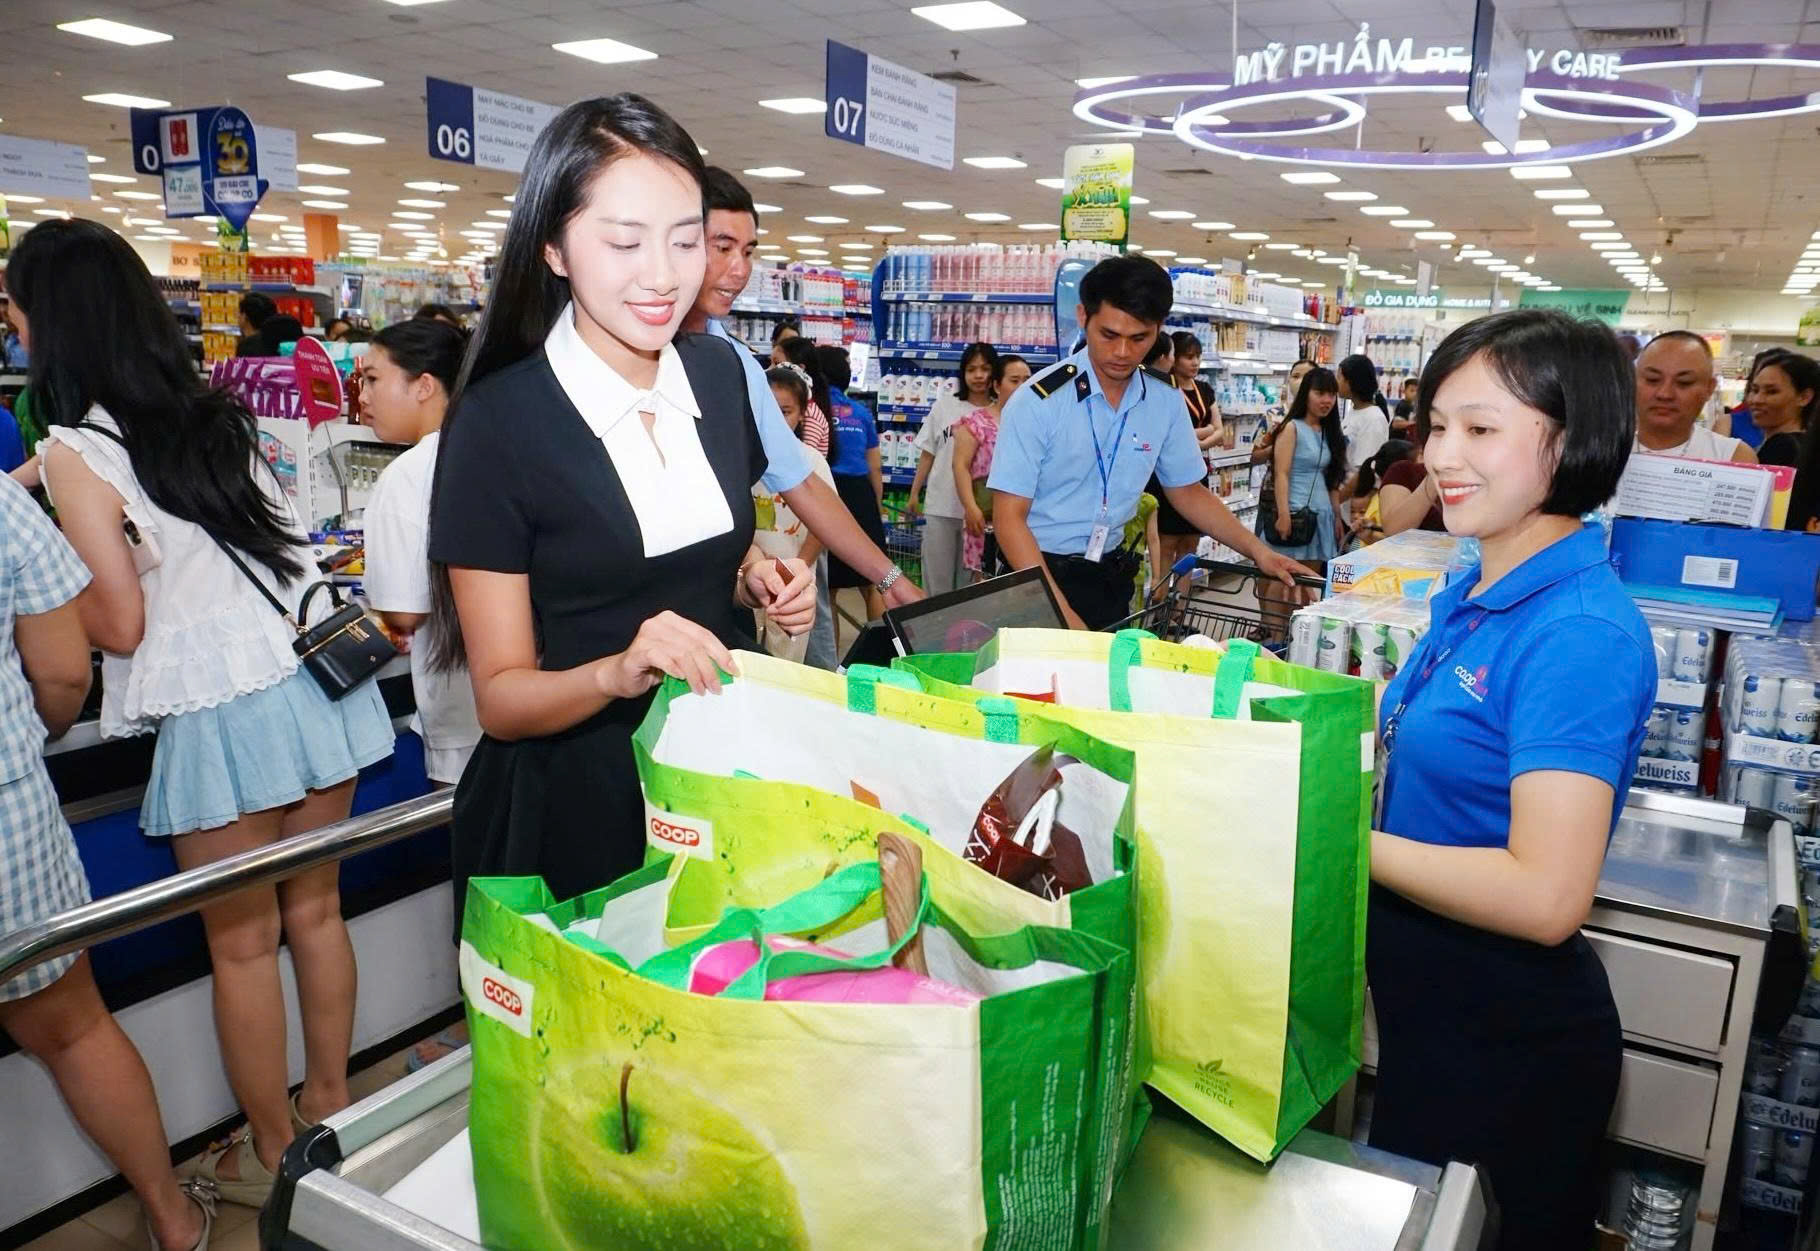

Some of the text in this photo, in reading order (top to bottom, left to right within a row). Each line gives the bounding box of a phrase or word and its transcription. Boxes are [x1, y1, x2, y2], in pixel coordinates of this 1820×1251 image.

[1234, 22, 1621, 86] MỸ PHẨM BEY CARE
[834, 97, 863, 136] 07
[437, 124, 471, 158] 06
[1365, 290, 1382, 306] ĐỒ
[1384, 295, 1403, 306] GIA
[1406, 295, 1437, 308] DỤNG
[1673, 466, 1713, 478] BẢNG GIÁ
[1332, 573, 1354, 584] PACK
[1334, 564, 1355, 574] COOL
[1634, 762, 1691, 782] elweiss
[652, 820, 698, 844] COOP
[484, 980, 521, 1011] COOP
[1194, 1082, 1234, 1108] RECYCLE
